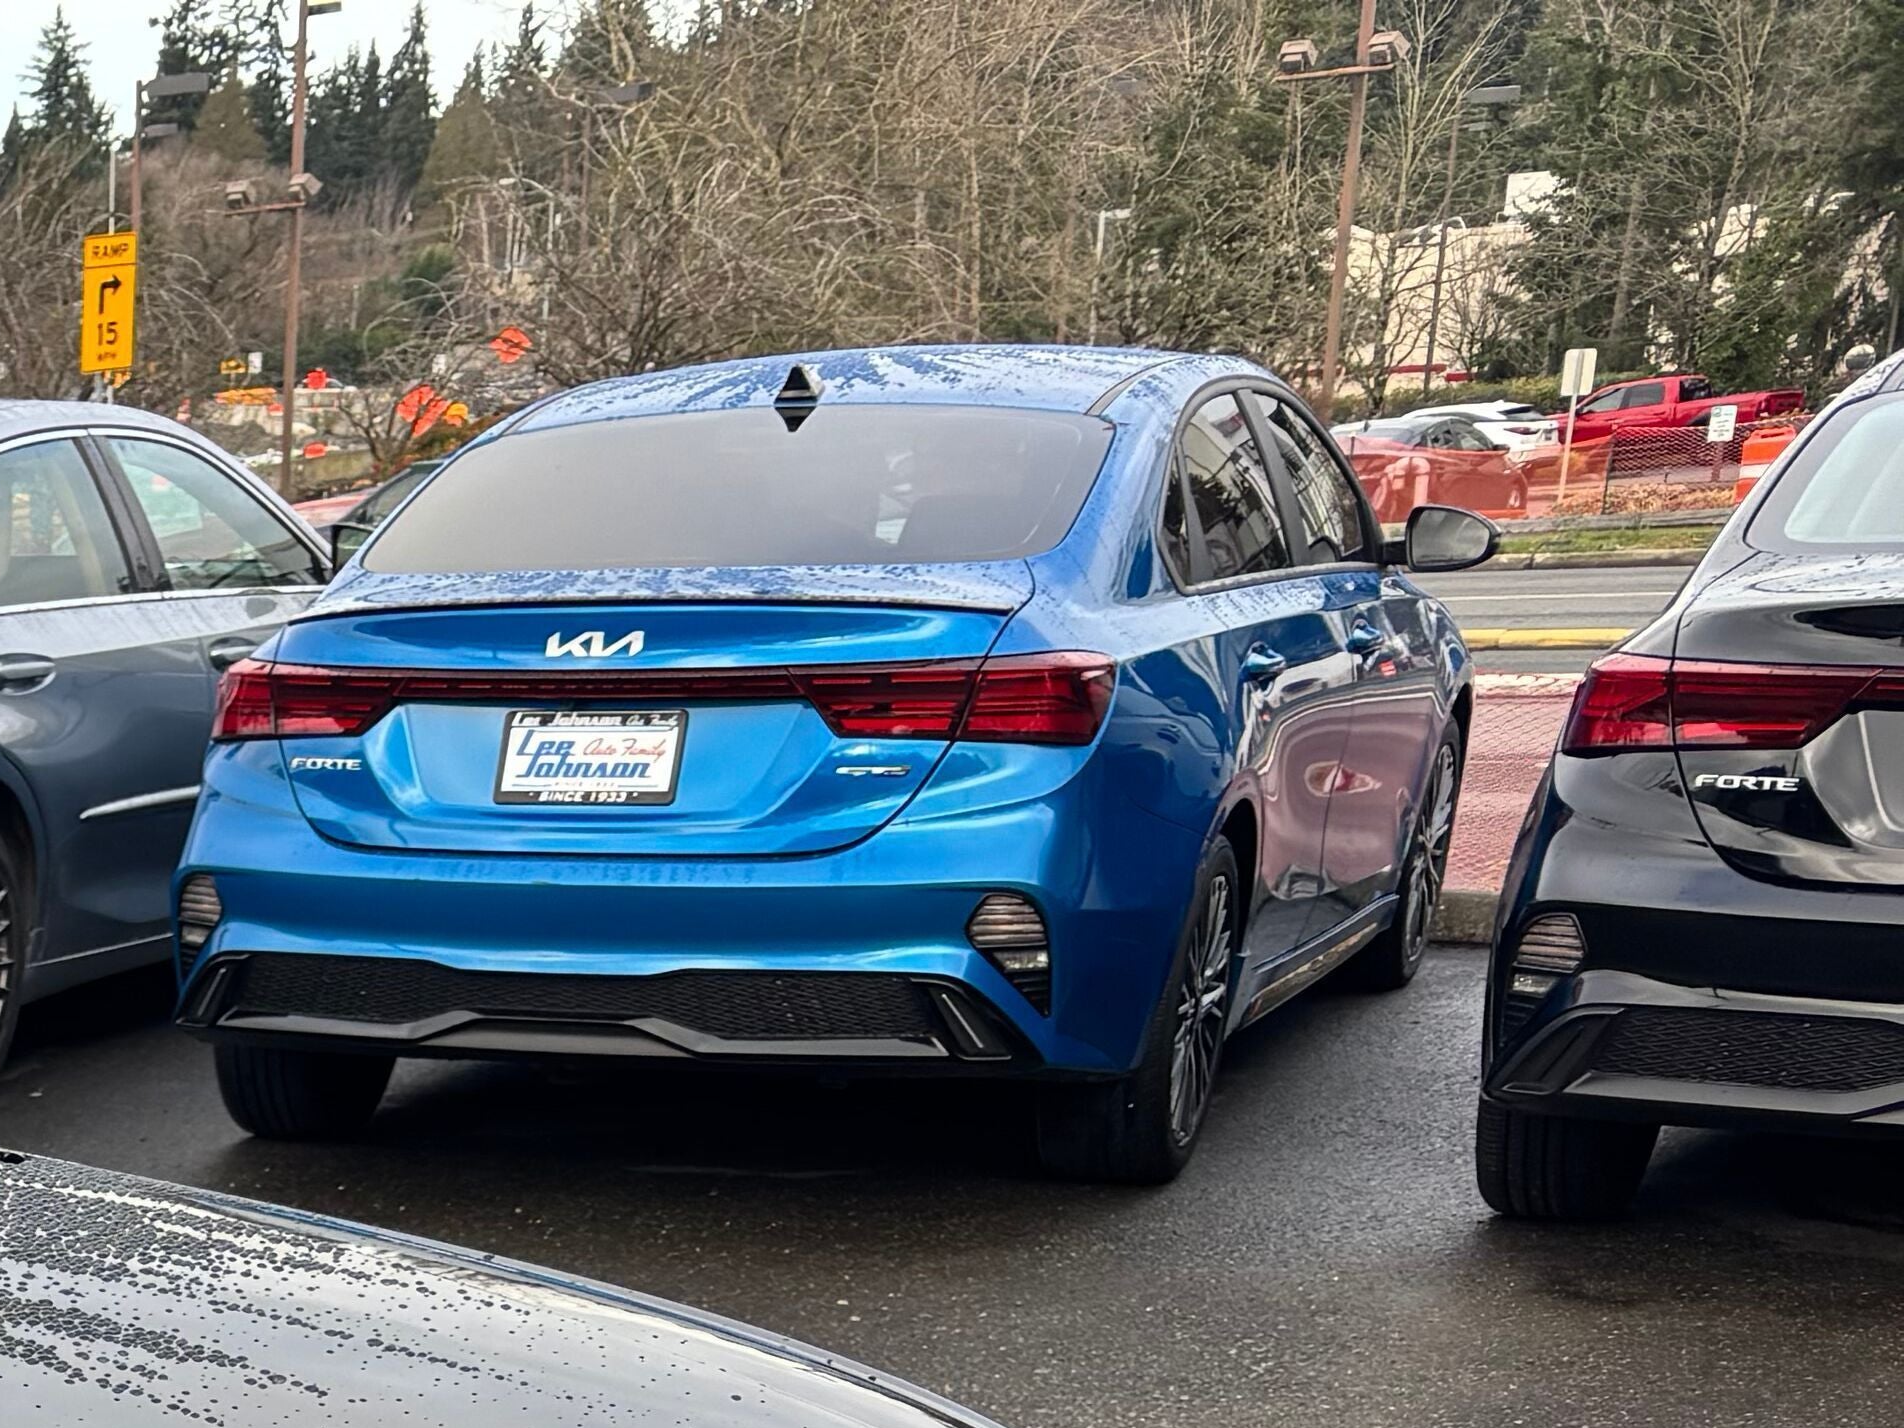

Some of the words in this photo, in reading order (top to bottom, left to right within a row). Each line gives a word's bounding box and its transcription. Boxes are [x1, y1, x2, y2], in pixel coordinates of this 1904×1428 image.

[98, 321, 118, 346] 15
[516, 730, 576, 756] Lee
[583, 738, 617, 756] Auto
[622, 738, 667, 763] Family
[291, 757, 362, 770] FORTE
[515, 752, 652, 778] Johnson
[1695, 774, 1800, 791] FORTE
[538, 791, 585, 802] SINCE
